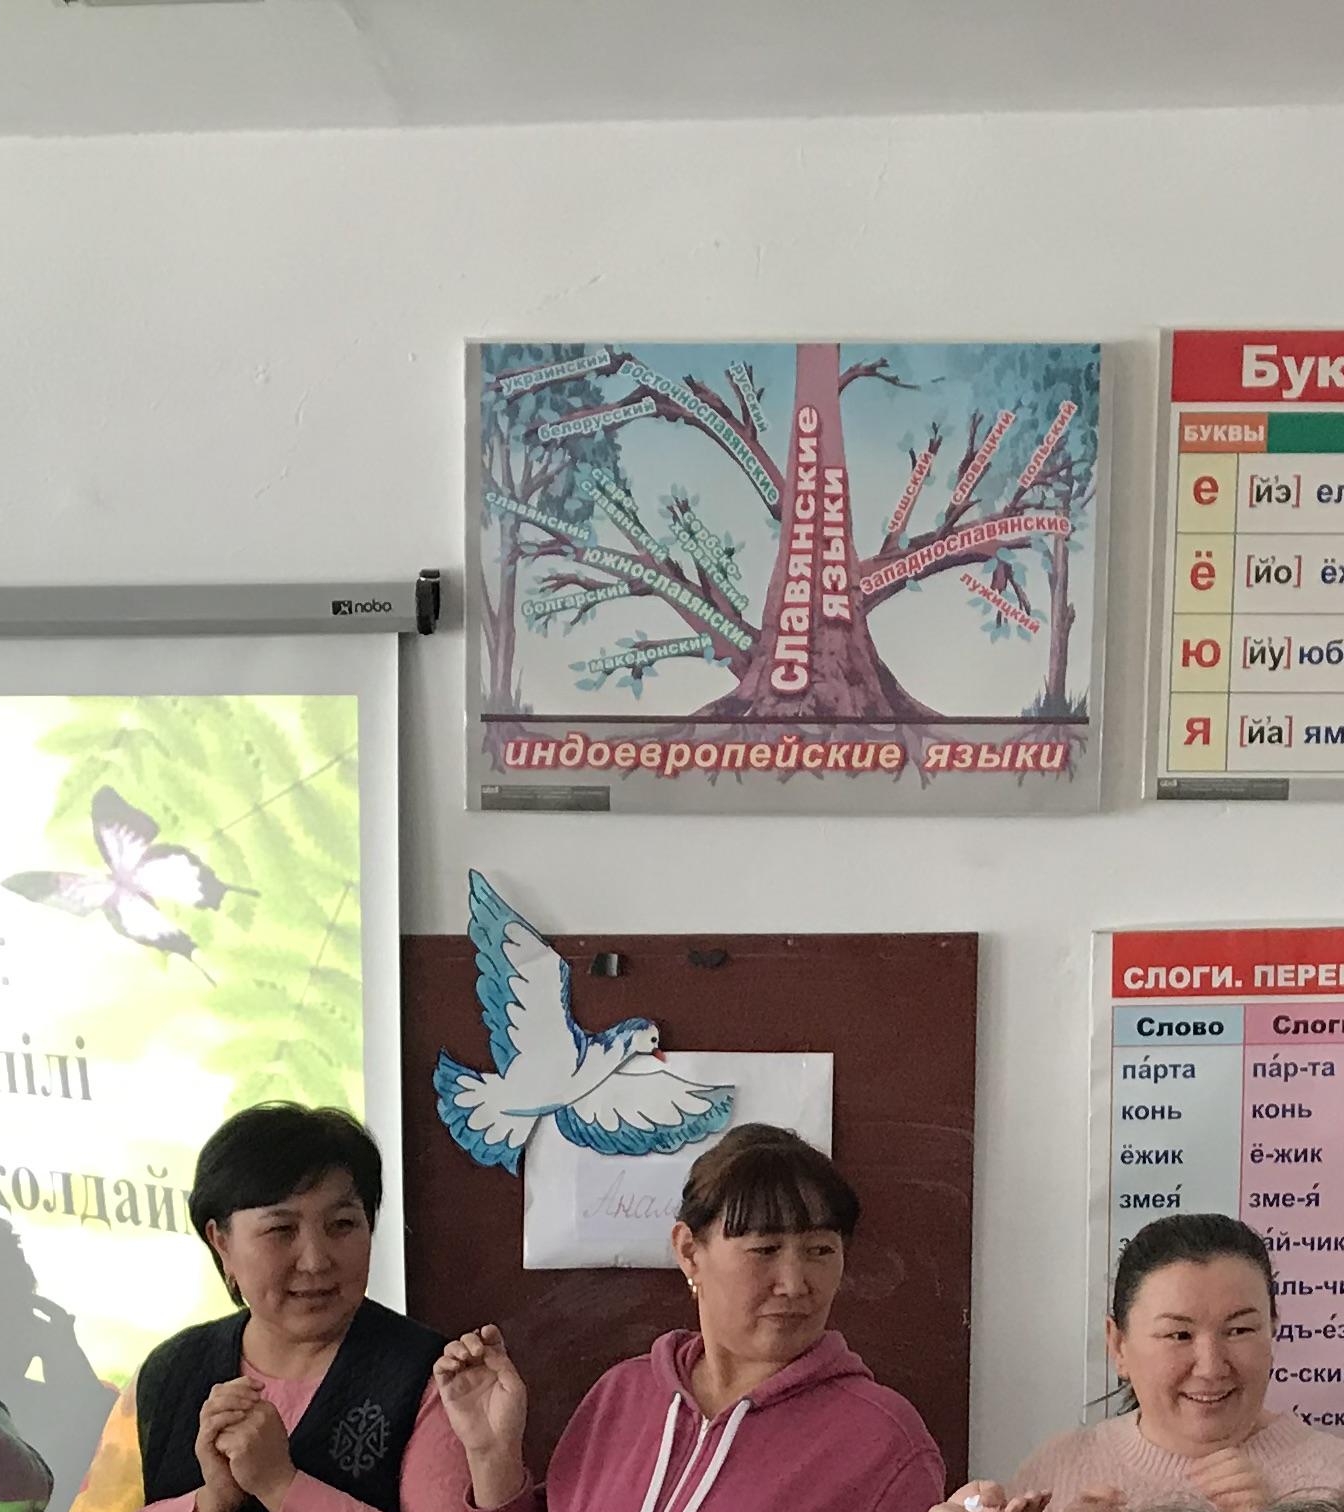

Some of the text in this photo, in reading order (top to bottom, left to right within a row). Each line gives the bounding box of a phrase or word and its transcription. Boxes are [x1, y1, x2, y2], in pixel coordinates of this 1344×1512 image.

[540, 398, 656, 438] белорусский
[621, 361, 779, 504] восточнославянские
[1184, 423, 1265, 443] БУКВЫ
[952, 411, 1016, 503] словацкий
[1020, 401, 1077, 488] польский
[888, 449, 935, 531] чешский
[1193, 475, 1219, 505] е
[771, 406, 818, 692] славянские
[823, 468, 850, 621] языки
[861, 517, 1069, 591] западнославянские
[1190, 551, 1216, 591] ё
[355, 599, 392, 613] nobo
[582, 547, 753, 652] южнославянские
[959, 572, 1041, 635] лужицкий
[589, 632, 712, 674] македонский
[1181, 638, 1221, 668] ю
[1183, 717, 1211, 746] я
[504, 734, 1065, 774] индоевропейские языки
[1123, 965, 1243, 989] СЛОГИ.
[1136, 1017, 1225, 1037] Слово
[1121, 1103, 1182, 1121] конь
[1251, 1102, 1313, 1119] конь
[1120, 1145, 1184, 1166] ёжик
[1250, 1146, 1322, 1164] ё-жик
